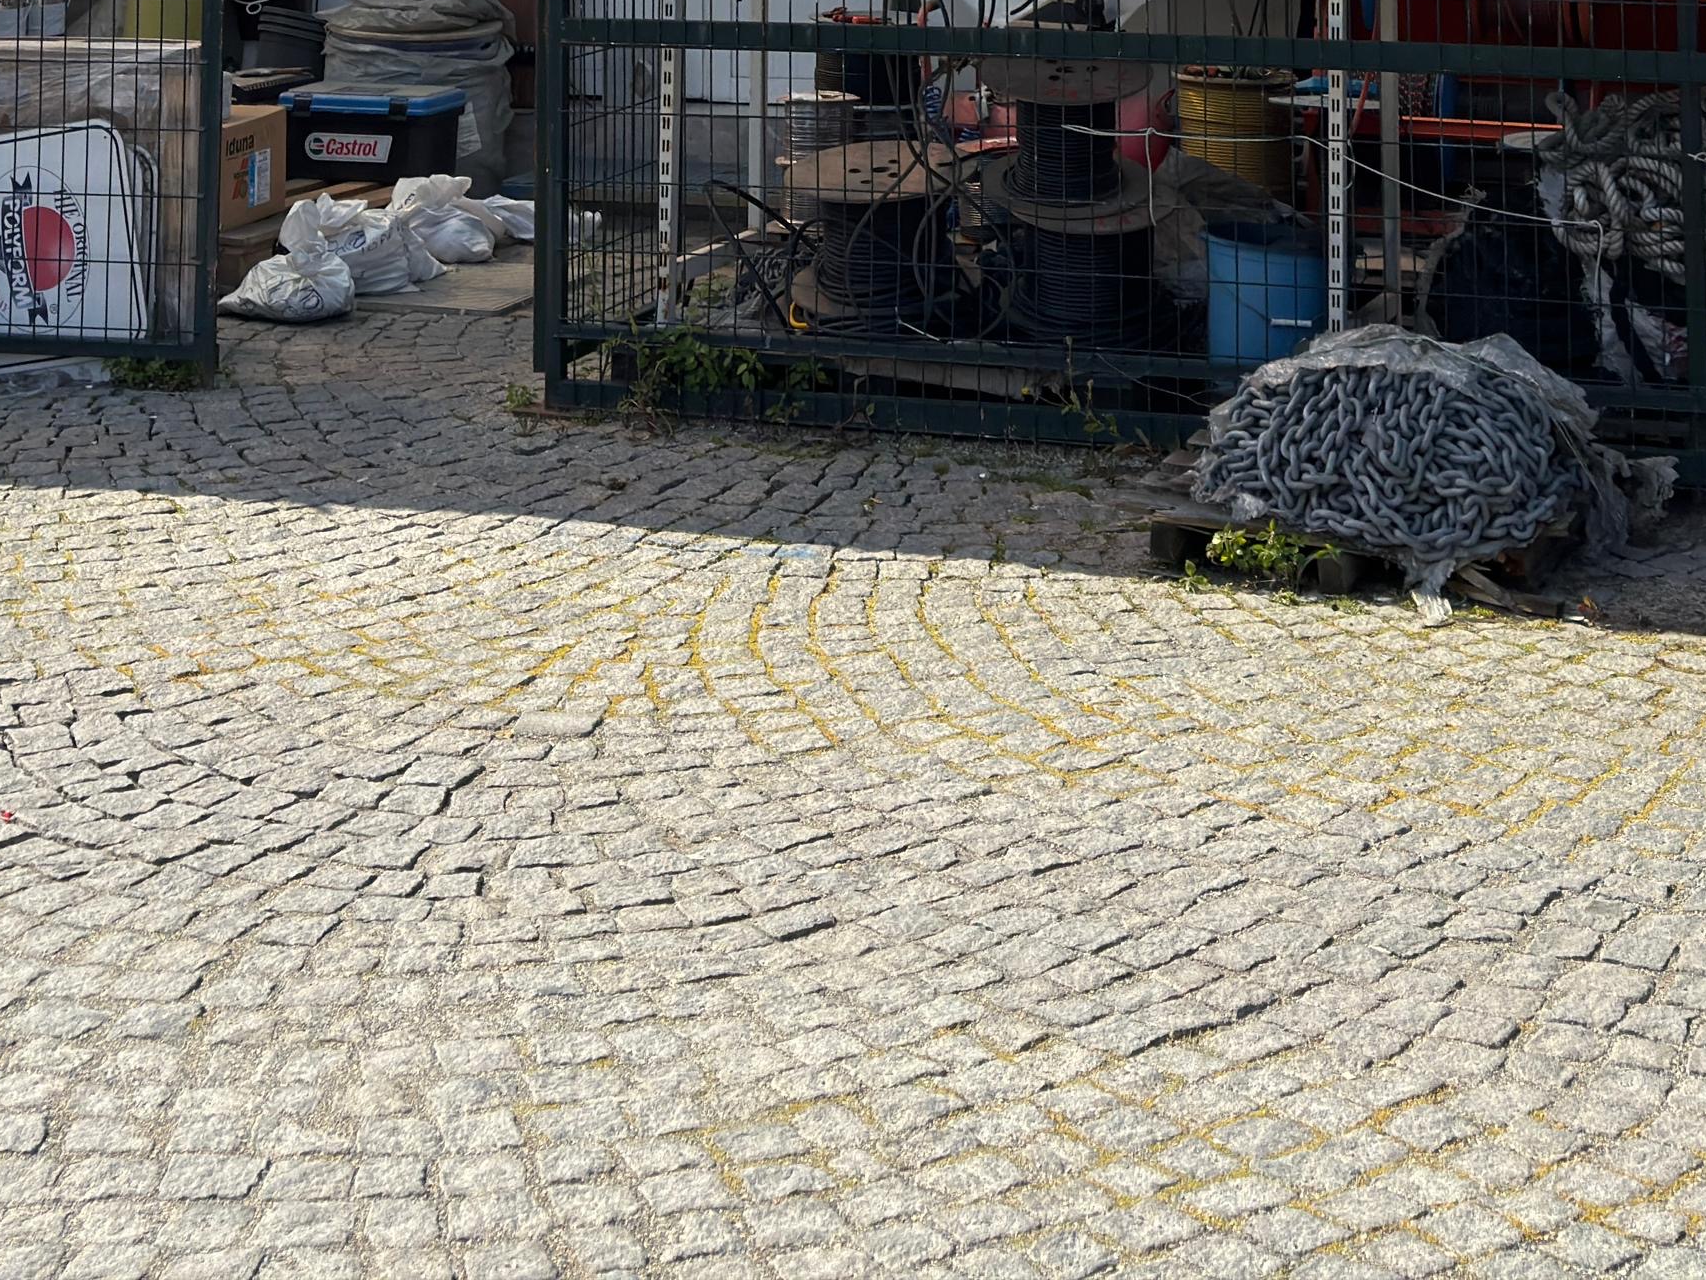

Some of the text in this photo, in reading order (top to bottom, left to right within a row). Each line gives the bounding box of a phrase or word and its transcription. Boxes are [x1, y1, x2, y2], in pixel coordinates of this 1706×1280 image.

[225, 134, 255, 157] Iduna
[326, 138, 378, 157] Castrol
[3, 198, 34, 310] POLYFORM
[53, 190, 89, 302] THE ORIGINAL
